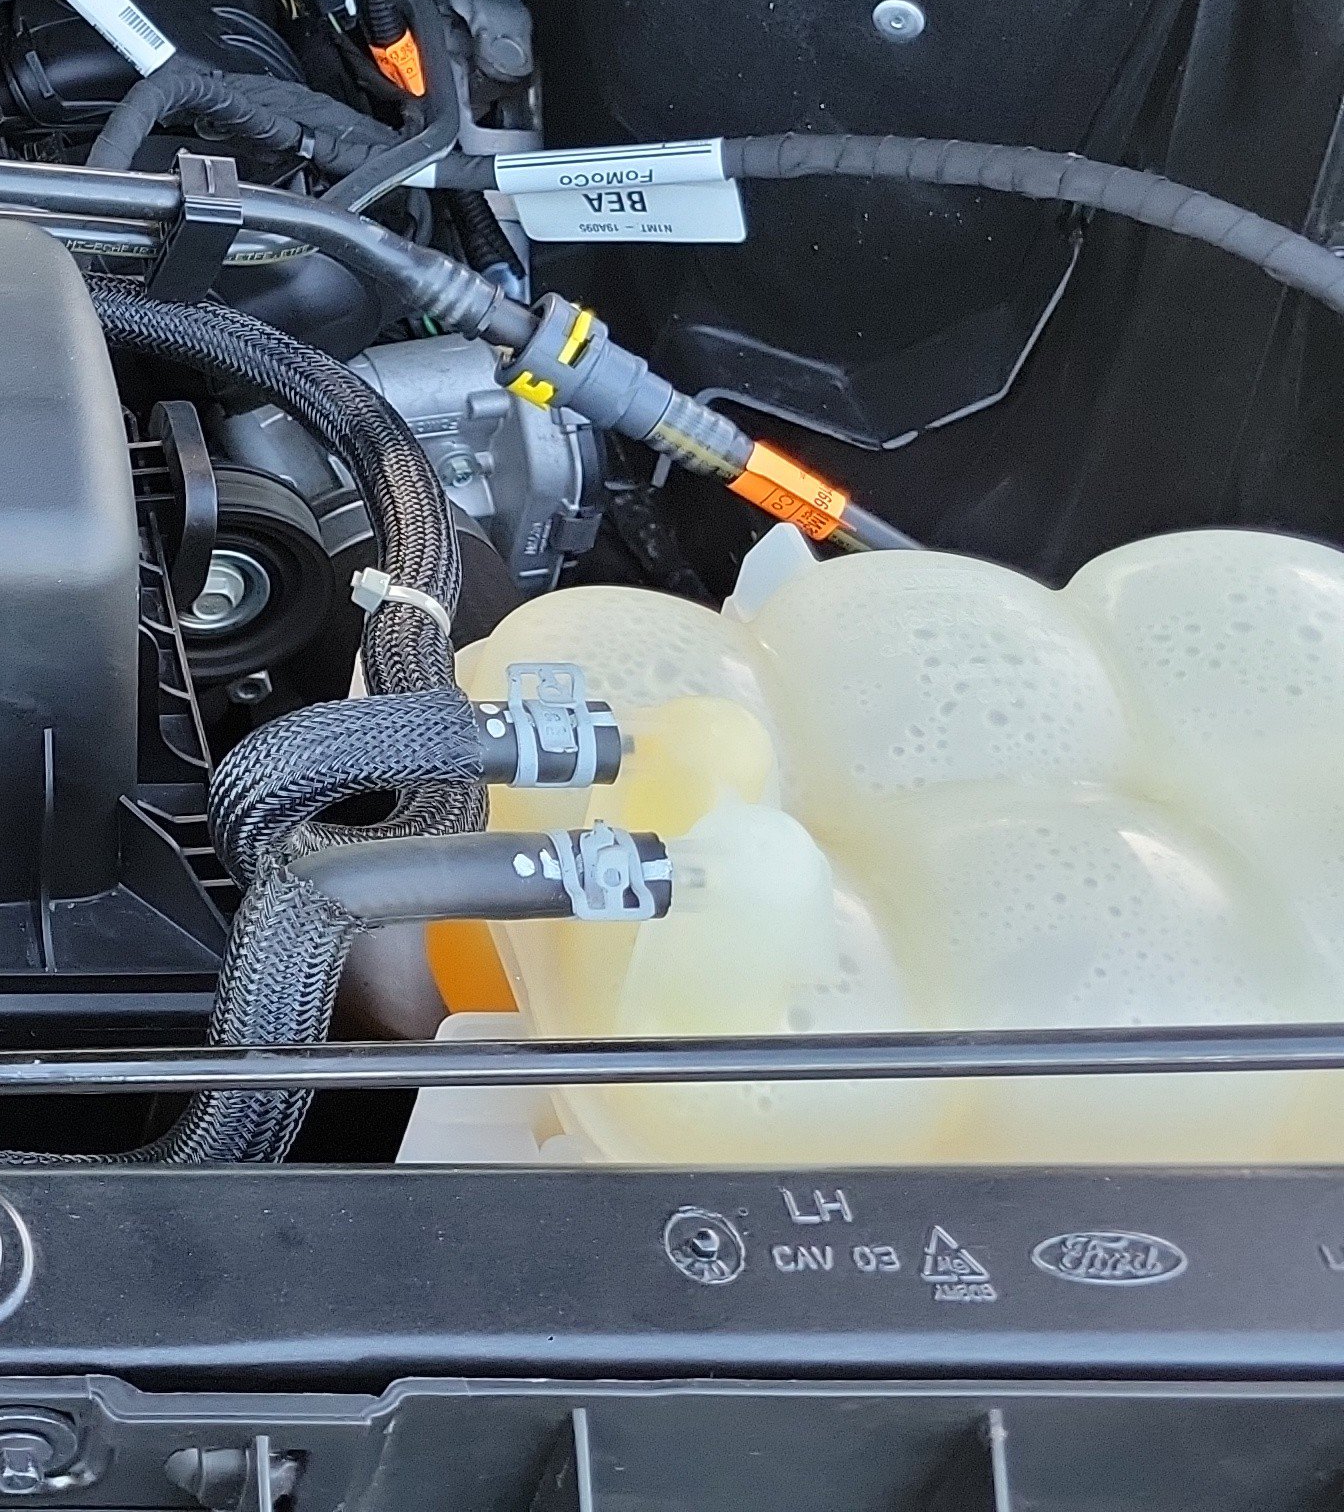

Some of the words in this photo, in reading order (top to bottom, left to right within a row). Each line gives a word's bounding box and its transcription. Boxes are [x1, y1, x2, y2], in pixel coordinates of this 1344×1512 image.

[559, 169, 654, 187] FoMoCo
[582, 190, 648, 214] BEA
[579, 222, 620, 234] 19A095
[641, 222, 673, 234] N1MT
[779, 1186, 853, 1224] LH
[770, 1244, 834, 1272] CAV
[853, 1245, 902, 1272] 03
[1058, 1234, 1162, 1277] Ford
